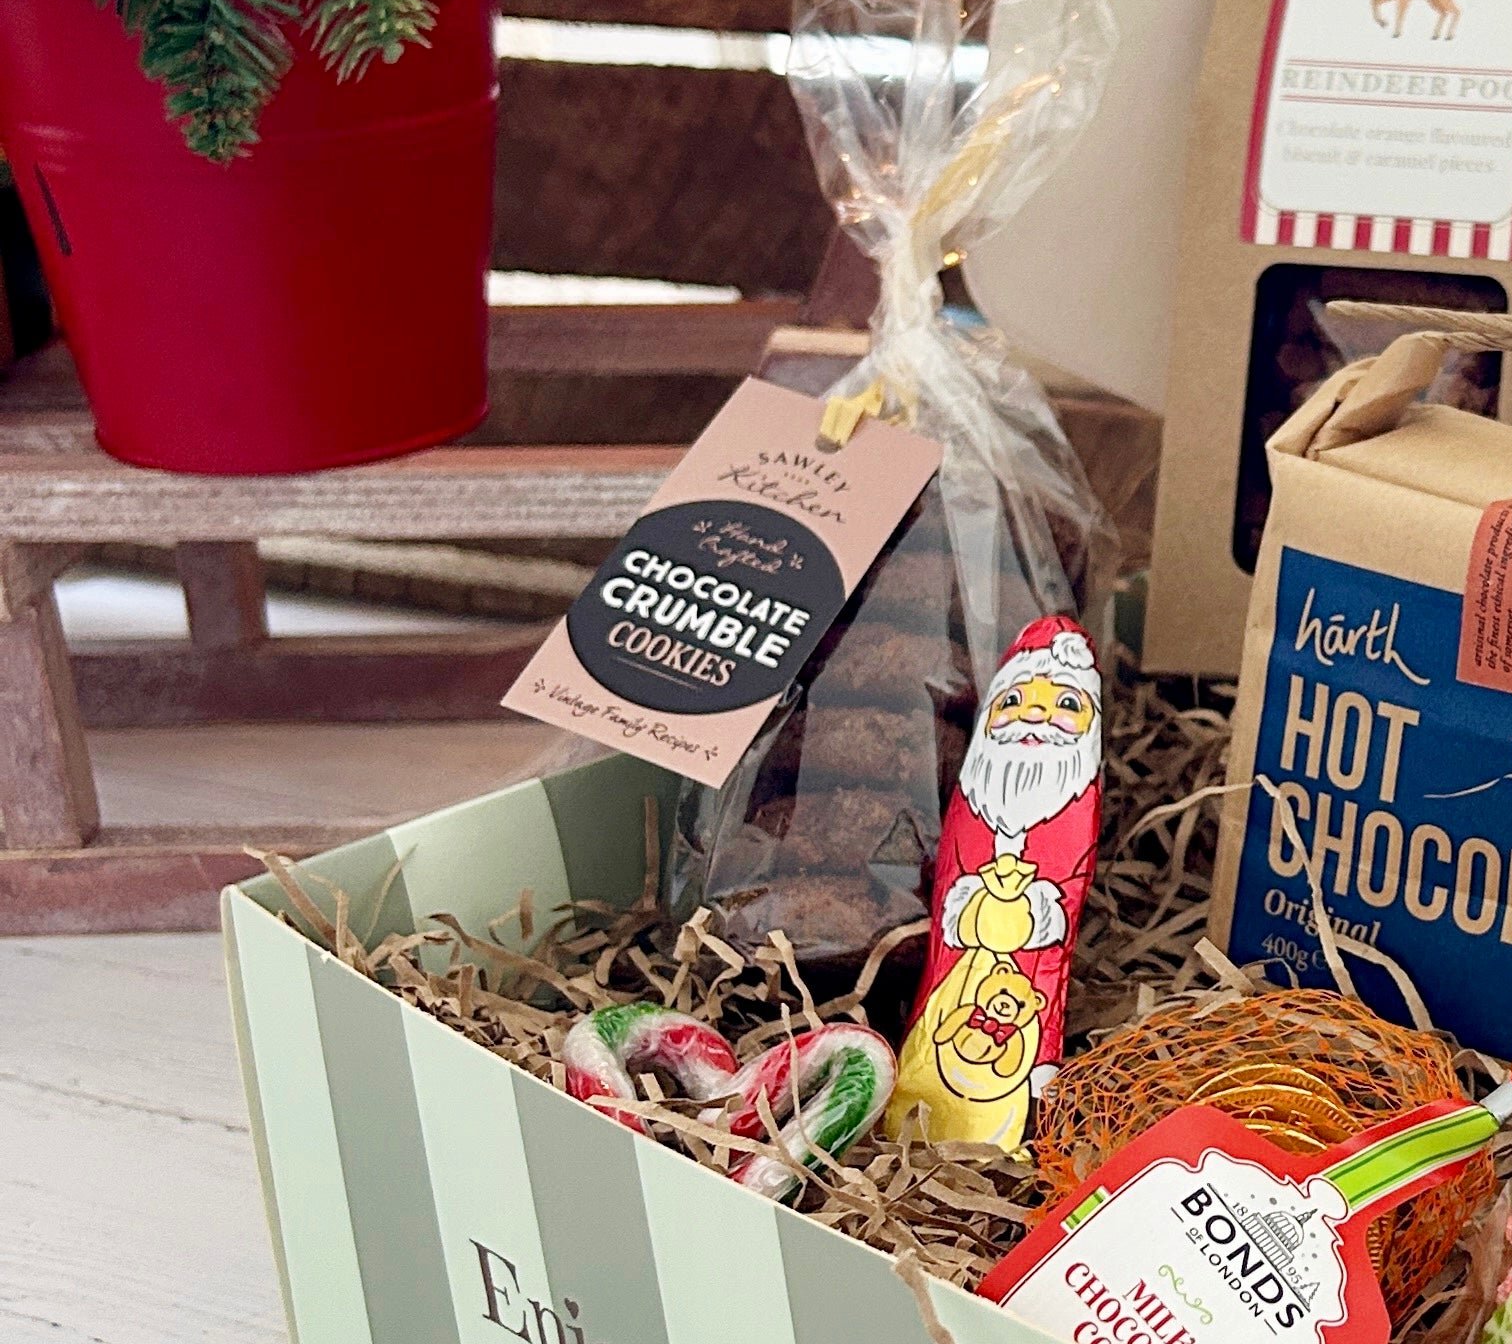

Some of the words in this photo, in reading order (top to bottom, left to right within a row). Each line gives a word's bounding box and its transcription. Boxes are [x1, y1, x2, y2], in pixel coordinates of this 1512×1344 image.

[1281, 68, 1448, 98] REINDEER
[717, 463, 847, 525] Kitchen
[758, 451, 849, 493] SAWLEY
[602, 575, 792, 669] CRUMBLE
[623, 549, 812, 637] CHOCOLATE
[608, 619, 737, 687] COOKIES
[1280, 674, 1420, 804] HOT
[1261, 932, 1309, 972] 400g
[1180, 1186, 1305, 1329] BONDS
[1189, 1226, 1204, 1241] OF
[1199, 1242, 1264, 1318] LONDON
[1286, 1266, 1303, 1285] 95
